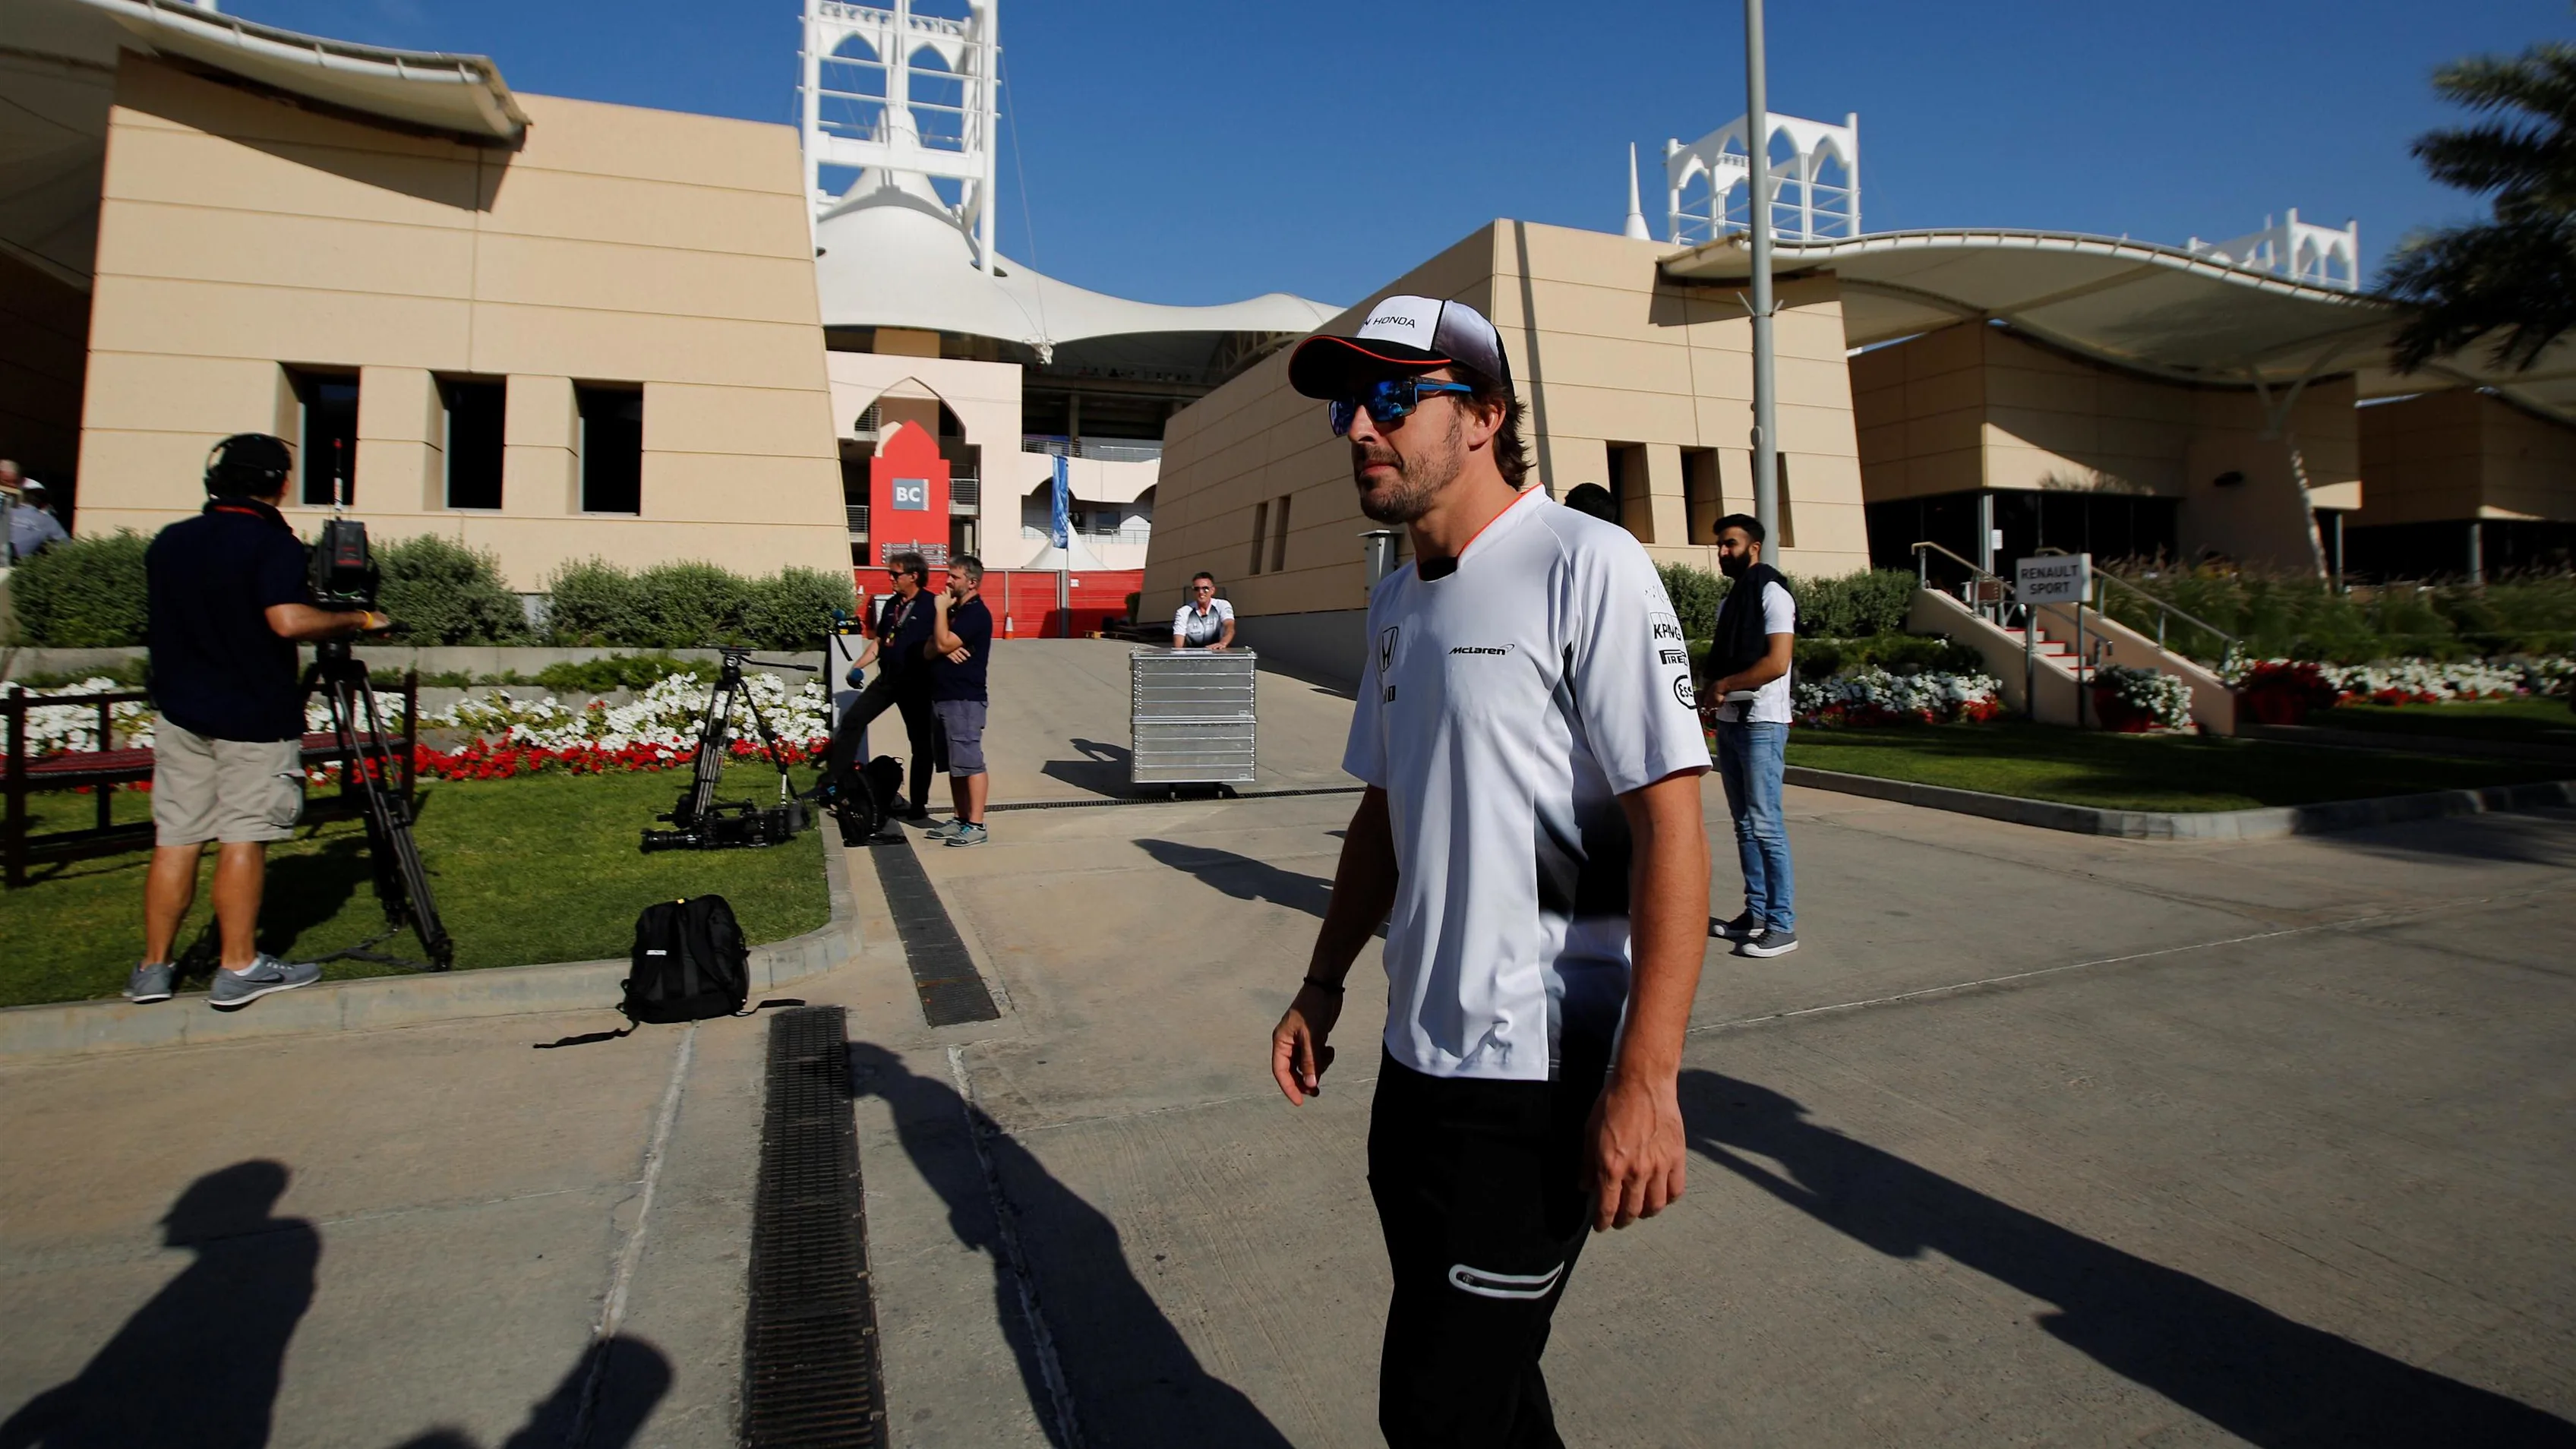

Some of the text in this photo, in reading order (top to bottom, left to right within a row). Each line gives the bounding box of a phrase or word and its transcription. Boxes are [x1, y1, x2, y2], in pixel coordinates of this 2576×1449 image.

[1373, 316, 1416, 328] HONDA
[896, 486, 921, 503] BC
[2021, 564, 2079, 579] RENAULT
[2029, 581, 2071, 595] SPORT
[1448, 646, 1506, 655] McLaren
